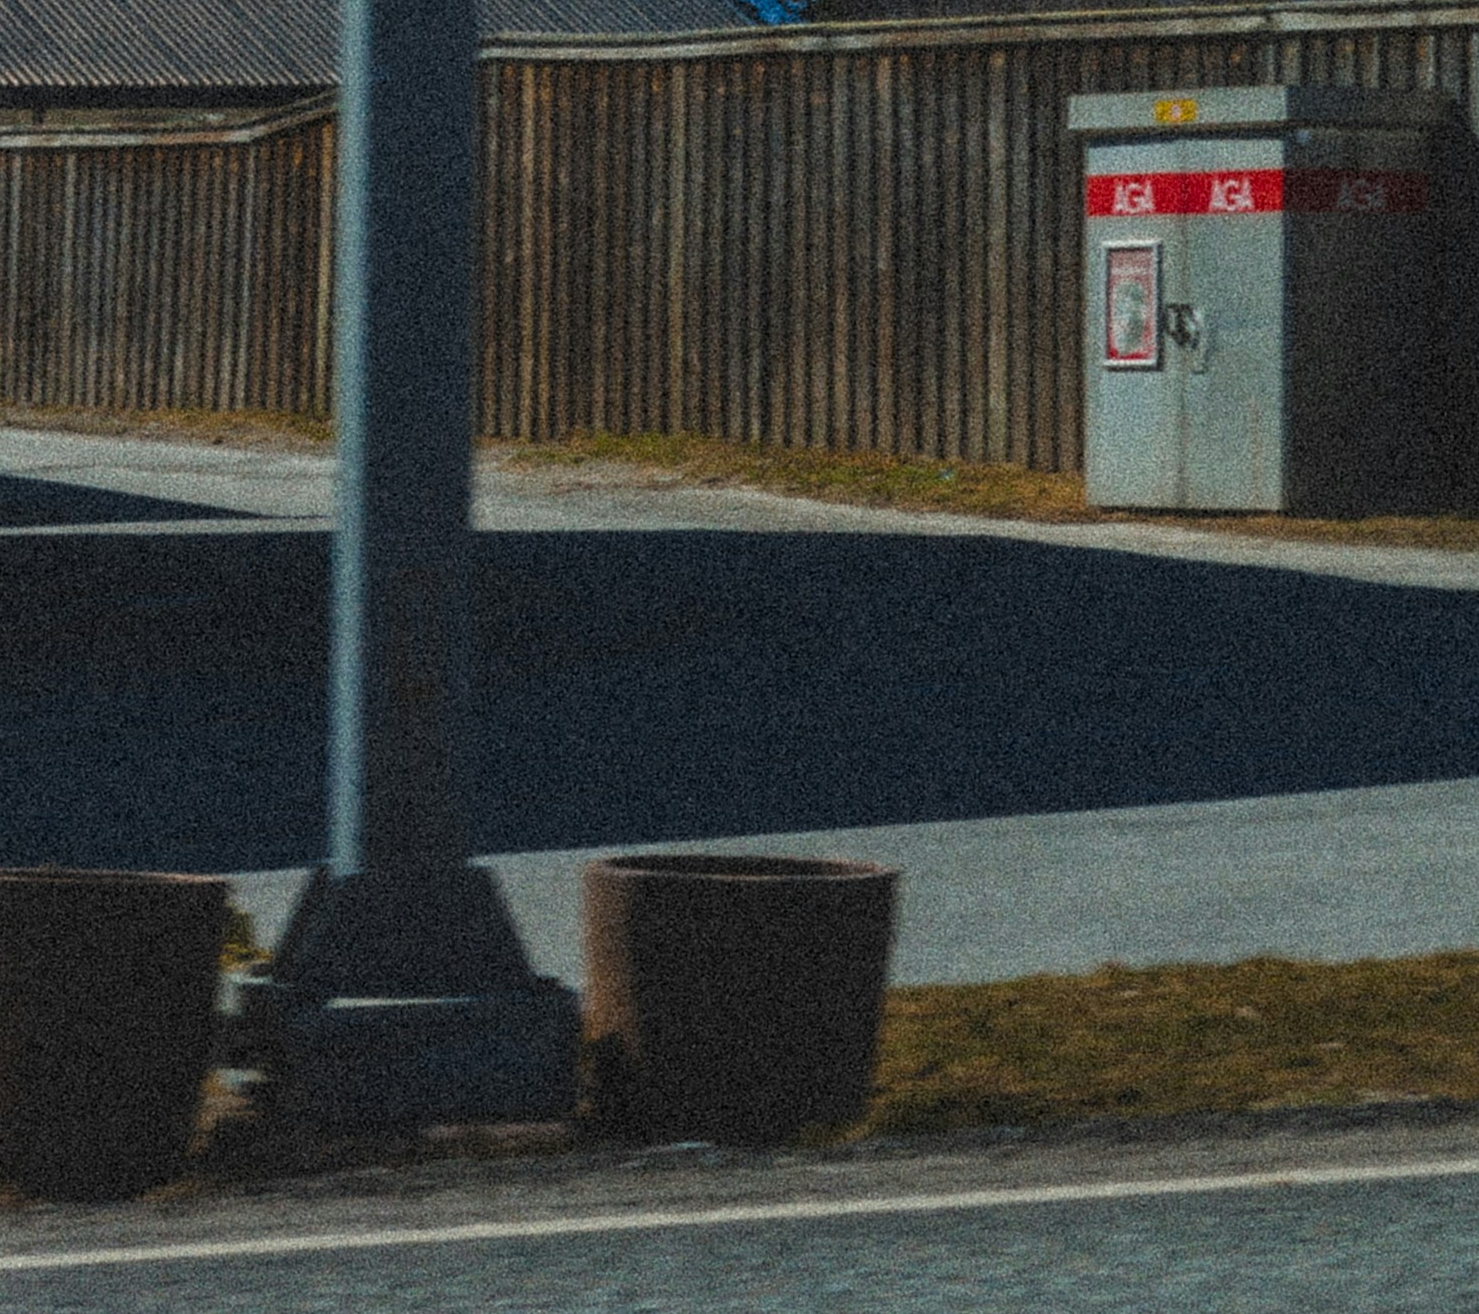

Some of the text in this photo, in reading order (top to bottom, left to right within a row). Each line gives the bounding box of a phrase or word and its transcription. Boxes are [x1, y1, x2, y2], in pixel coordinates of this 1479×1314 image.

[1114, 180, 1156, 213] AGA
[1209, 175, 1256, 212] AGA
[1337, 178, 1388, 210] AGA
